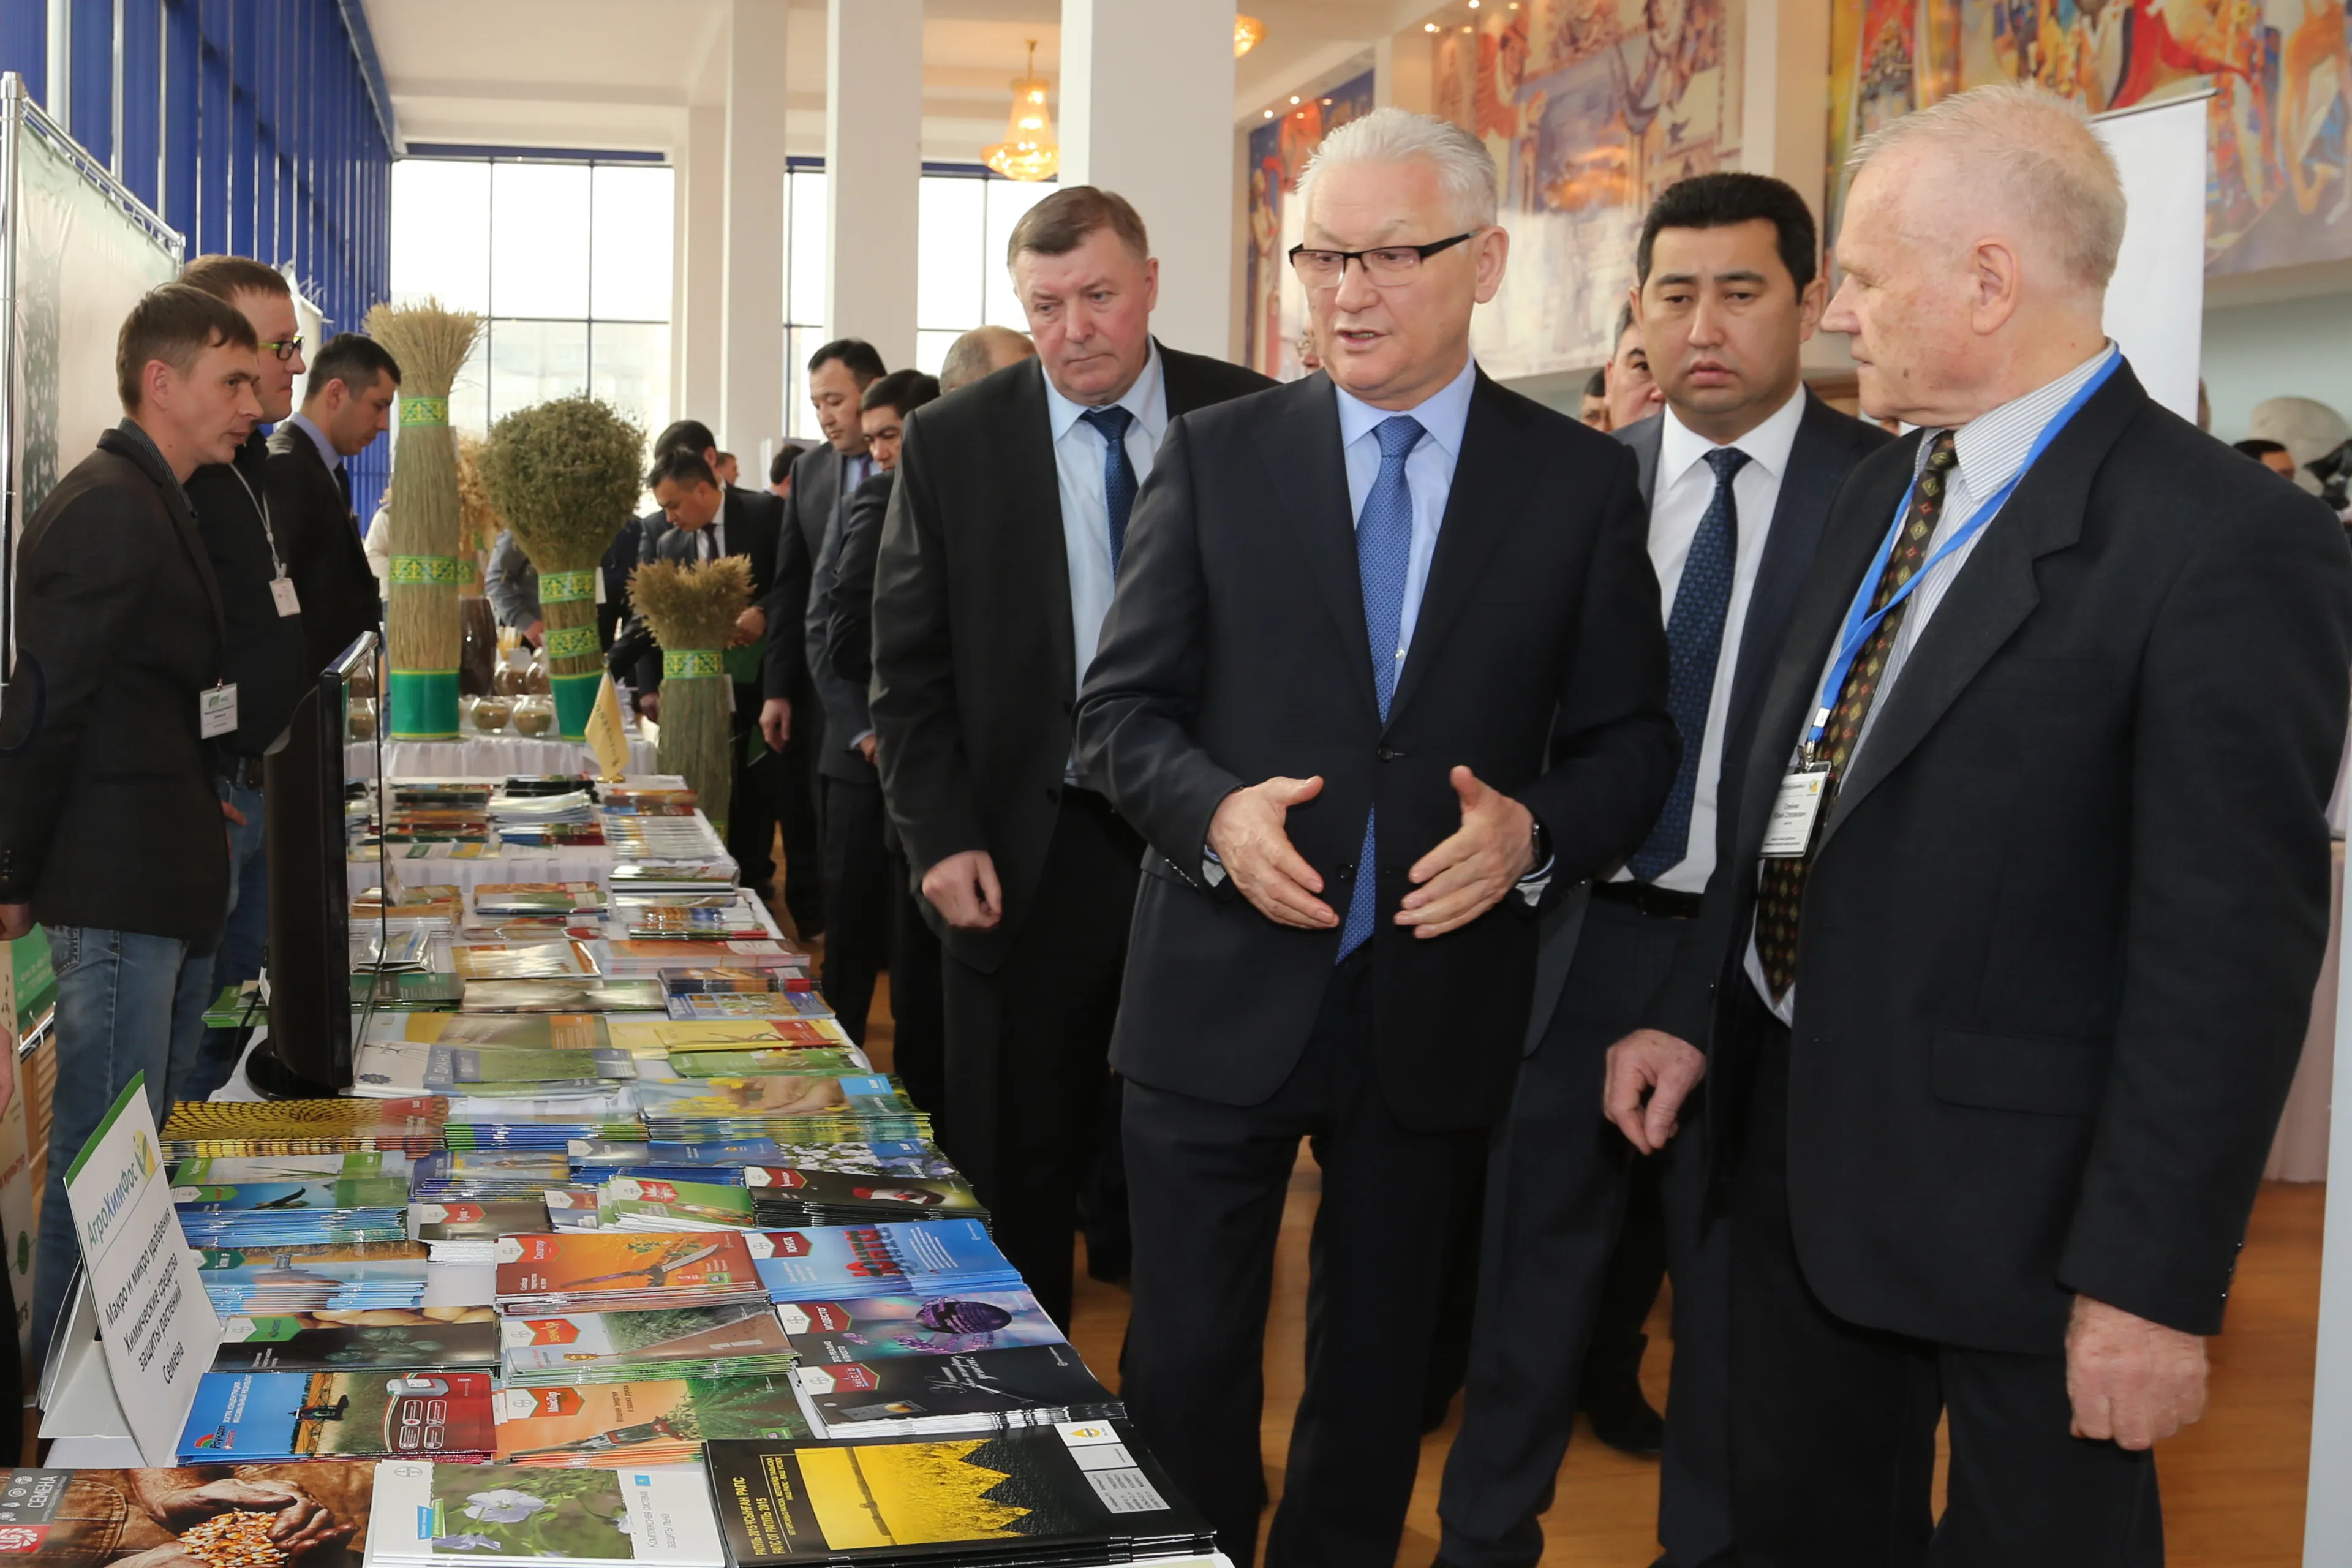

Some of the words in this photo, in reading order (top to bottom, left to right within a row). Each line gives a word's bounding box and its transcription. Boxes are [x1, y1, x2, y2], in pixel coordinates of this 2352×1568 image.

[86, 1162, 138, 1251] АгроХимФос
[783, 1237, 798, 1253] ЮНТА
[105, 1287, 128, 1329] Макро
[126, 1278, 134, 1295] и
[132, 1250, 149, 1287] микро
[147, 1207, 172, 1263] удобрения
[124, 1289, 160, 1357] Химические
[158, 1253, 178, 1298] средства
[139, 1324, 162, 1373] защиты
[159, 1278, 182, 1338] растений
[818, 1307, 834, 1330] МОДЕСТО
[162, 1341, 184, 1384] Семена
[209, 1425, 226, 1449] Раундап
[27, 1476, 58, 1508] СЕМЕНА
[733, 1477, 748, 1496] РАПС
[756, 1498, 770, 1512] 2015
[646, 1511, 658, 1548] Комплексная
[746, 1525, 760, 1537] 2015
[761, 1512, 778, 1532] РАПУЛЬ
[663, 1527, 677, 1548] защиты
[751, 1537, 767, 1556] РАПУЛЬ
[769, 1540, 786, 1555] РАПС
